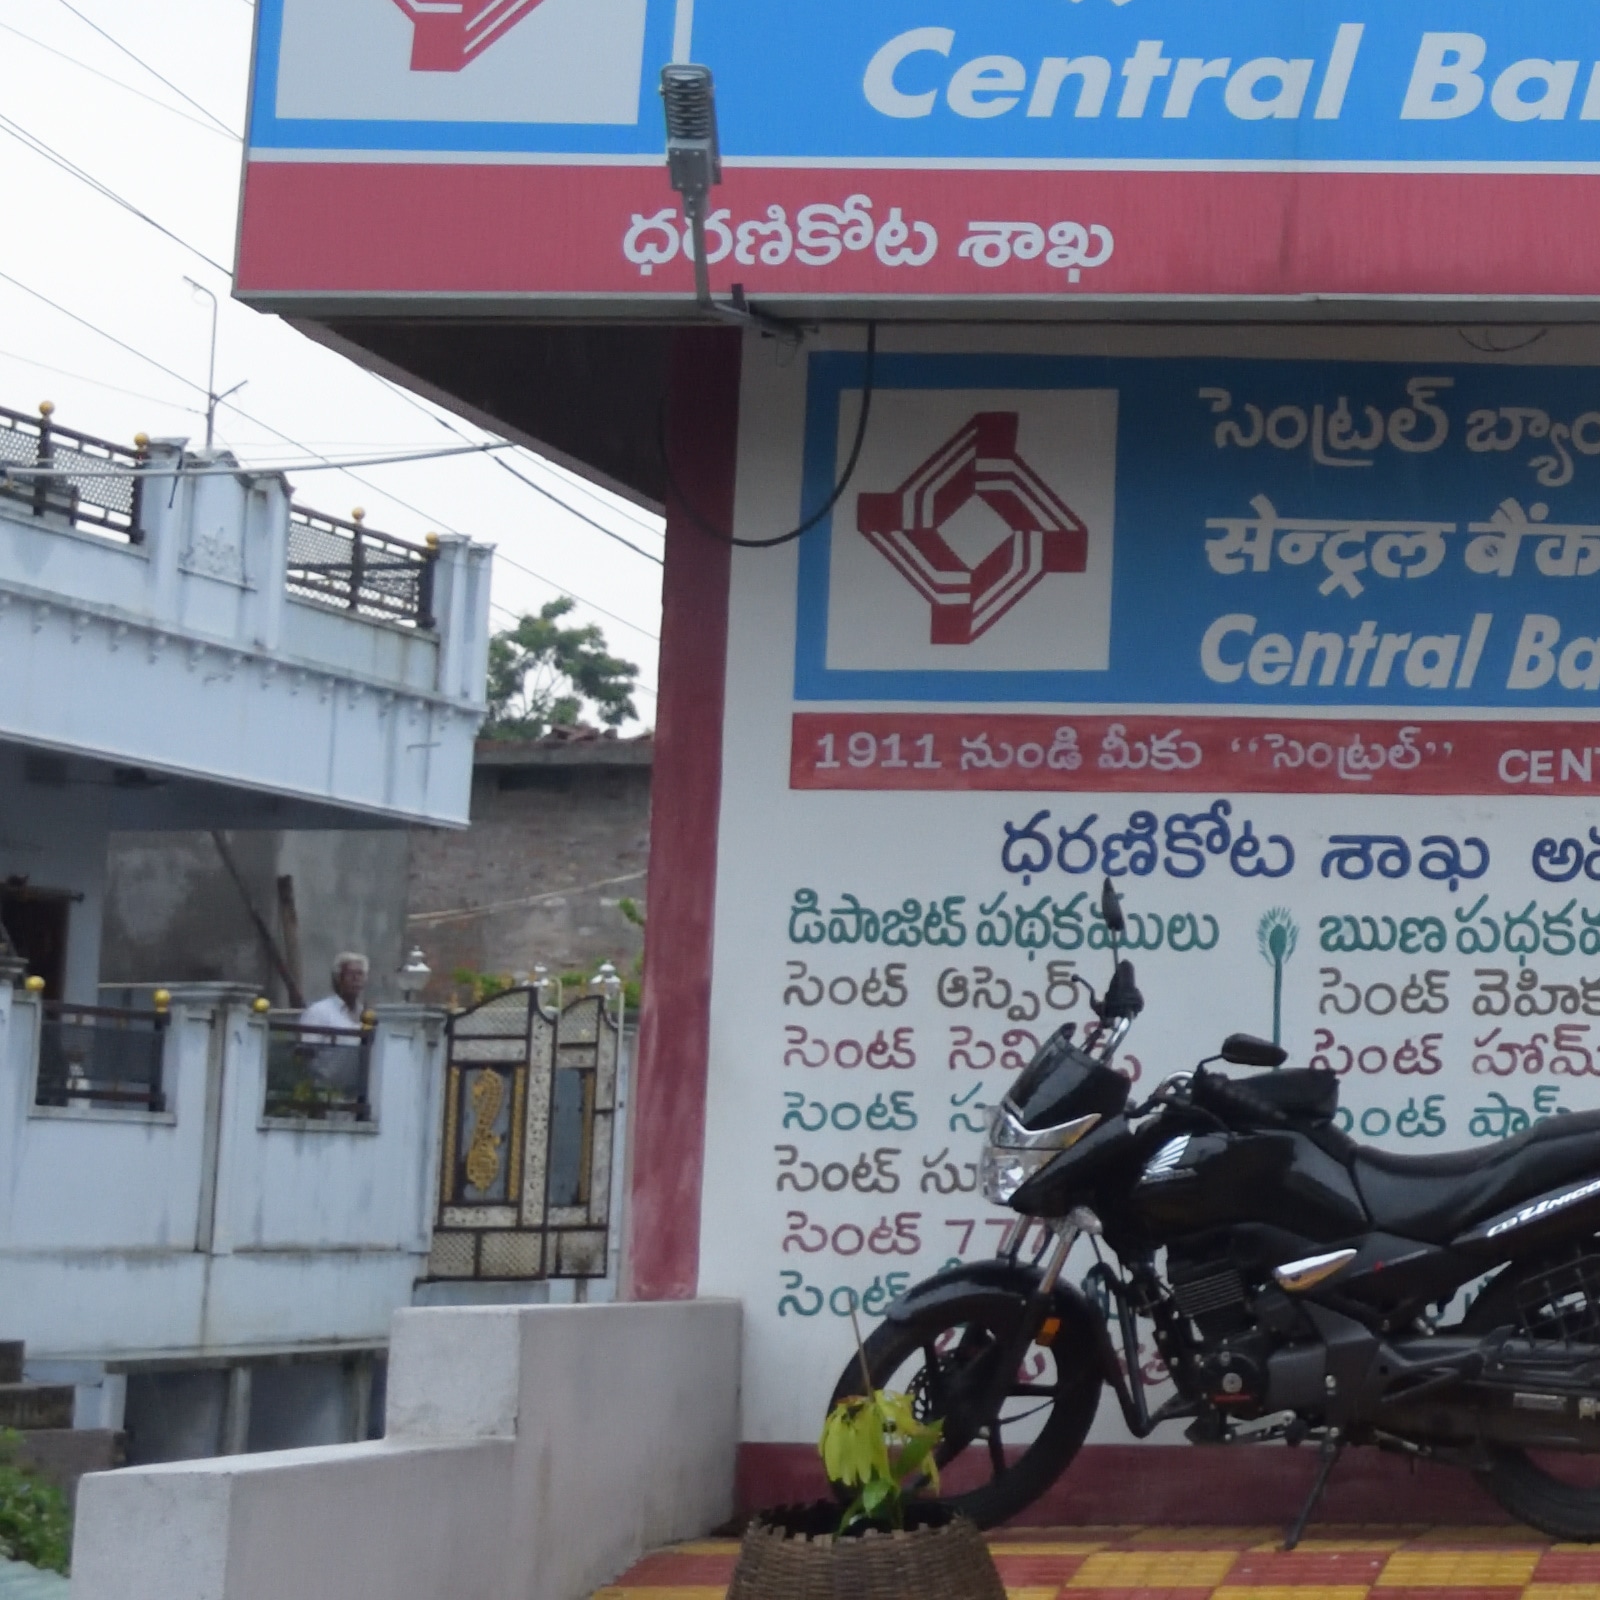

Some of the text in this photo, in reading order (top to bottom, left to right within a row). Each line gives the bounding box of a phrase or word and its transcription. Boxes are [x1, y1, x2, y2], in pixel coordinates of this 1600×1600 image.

[862, 23, 1359, 122] Central
[623, 193, 1115, 283] ధరణికోట శాఖ
[1198, 377, 1455, 467] సెంట్రల్
[1204, 493, 1457, 600] सेन्ट्रल
[1200, 612, 1493, 691] Central
[815, 726, 1202, 774] 1911 నుండి మీకు
[1000, 799, 1296, 887] ధరణికోట
[1320, 831, 1491, 892] శాఖ
[788, 887, 967, 948] డిపాజిట్
[783, 959, 909, 1008] సెంట్
[1318, 967, 1450, 1018] సెంట్
[783, 1024, 917, 1071] సెంట్
[782, 1090, 919, 1134] సెంట్
[774, 1144, 902, 1195] సెంట్
[782, 1211, 923, 1257] సెంట్
